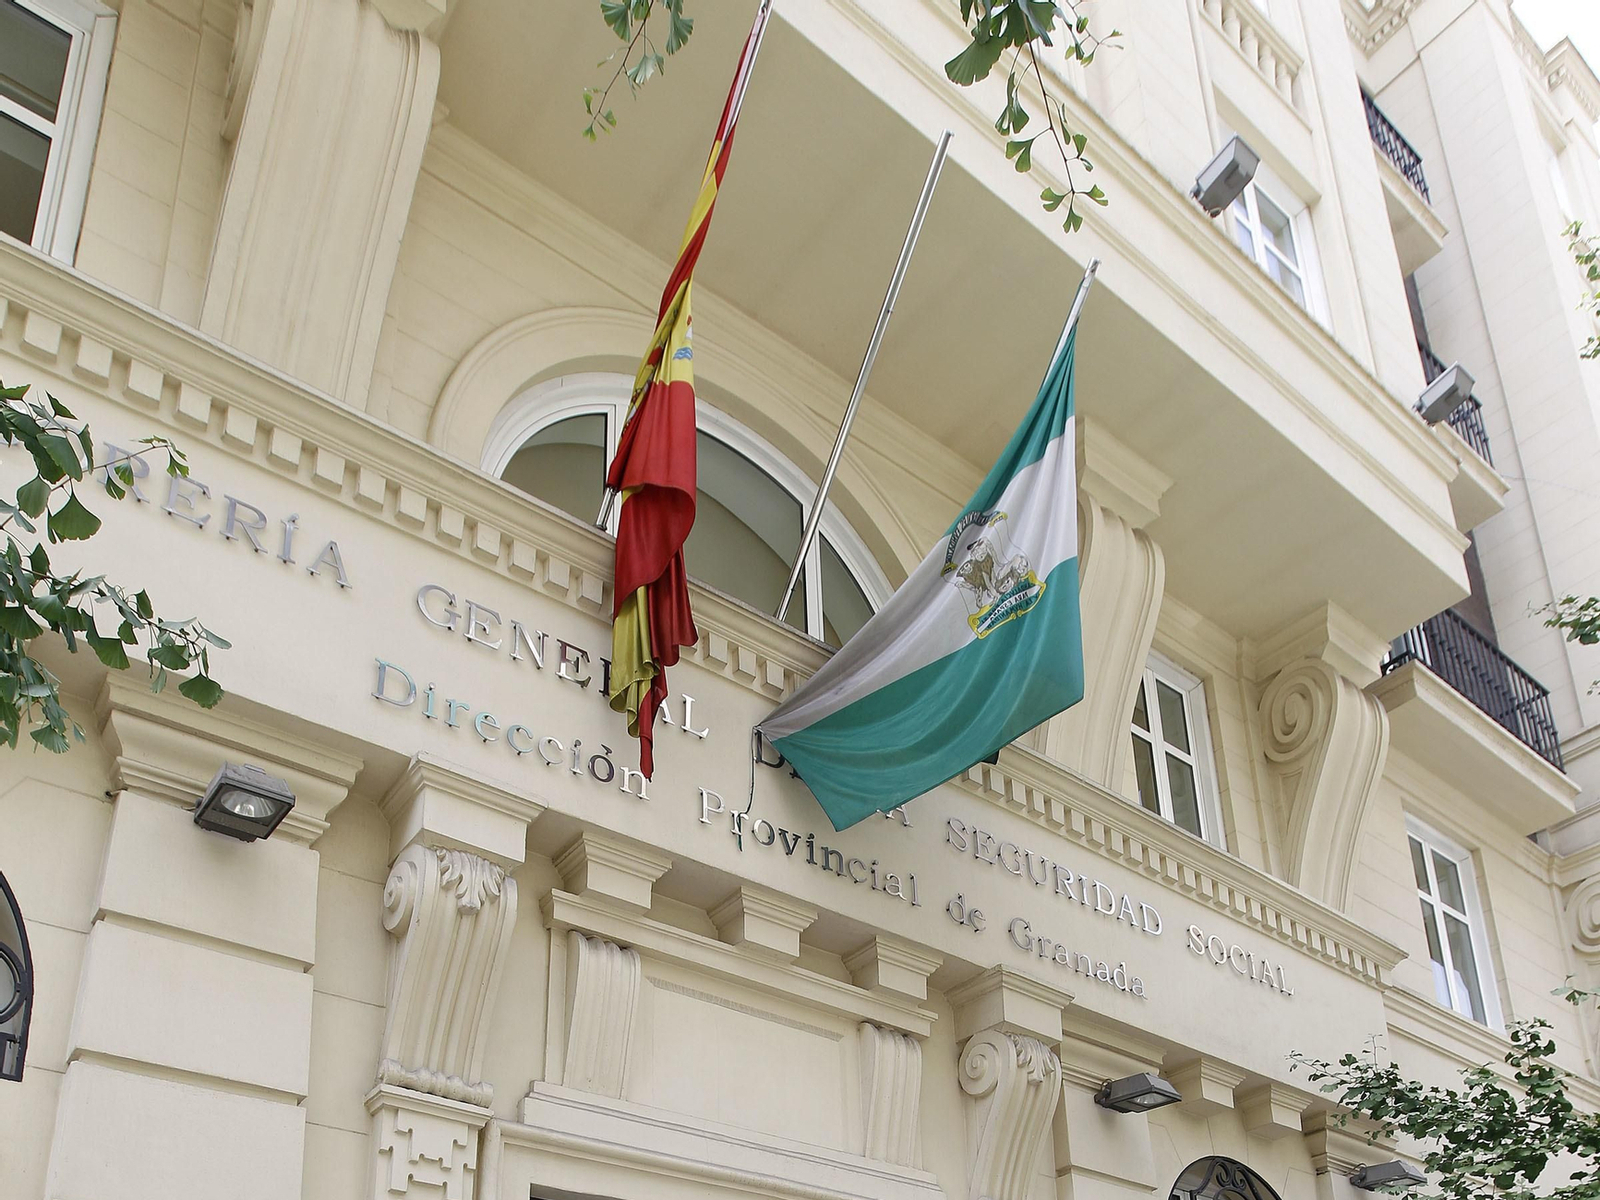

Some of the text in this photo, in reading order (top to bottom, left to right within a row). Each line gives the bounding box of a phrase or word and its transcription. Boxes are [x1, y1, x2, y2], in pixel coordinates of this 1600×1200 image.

[698, 786, 922, 907] Provincial
[946, 892, 986, 934] de
[1008, 916, 1149, 1000] Granada
[946, 817, 1163, 937] SEGURIDAD
[1187, 923, 1295, 997] SOCIAL
